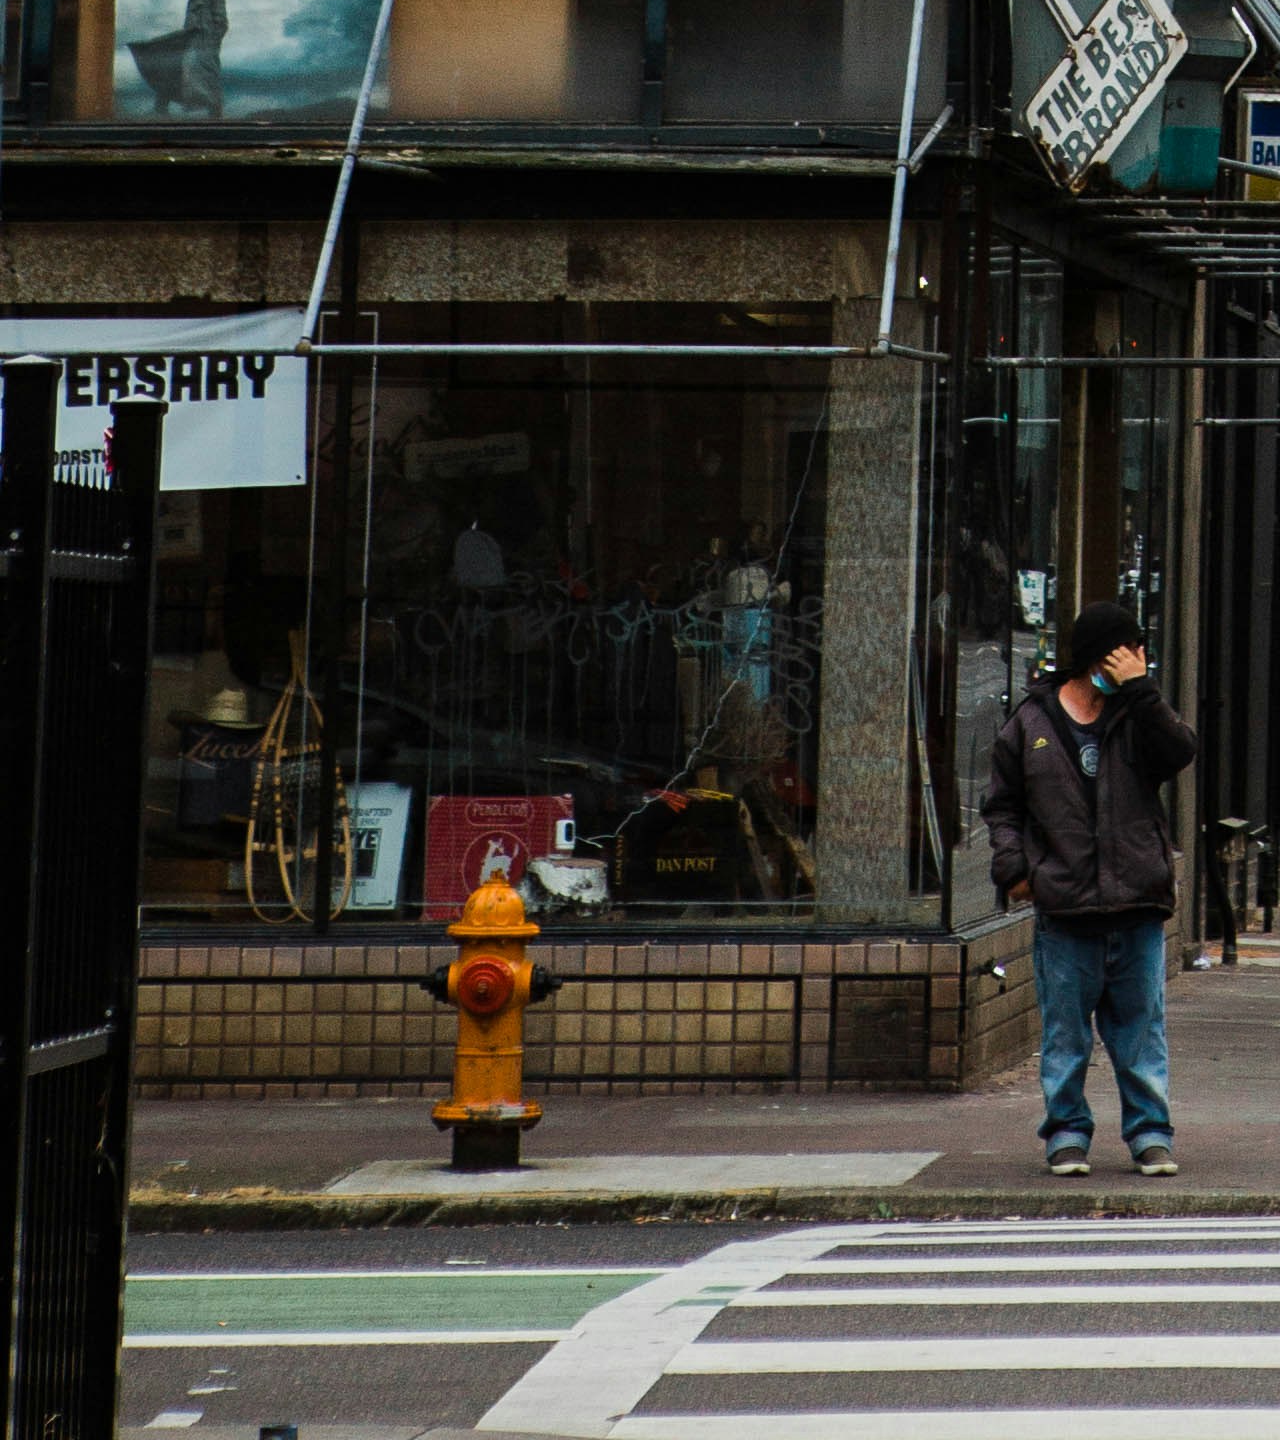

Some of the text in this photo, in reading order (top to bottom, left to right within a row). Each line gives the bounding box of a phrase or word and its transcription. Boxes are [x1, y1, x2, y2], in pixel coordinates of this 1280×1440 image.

[1037, 65, 1092, 137] THE
[64, 354, 277, 409] ERSARY
[472, 802, 529, 818] PENDLETON
[656, 856, 717, 872] DAN POST
